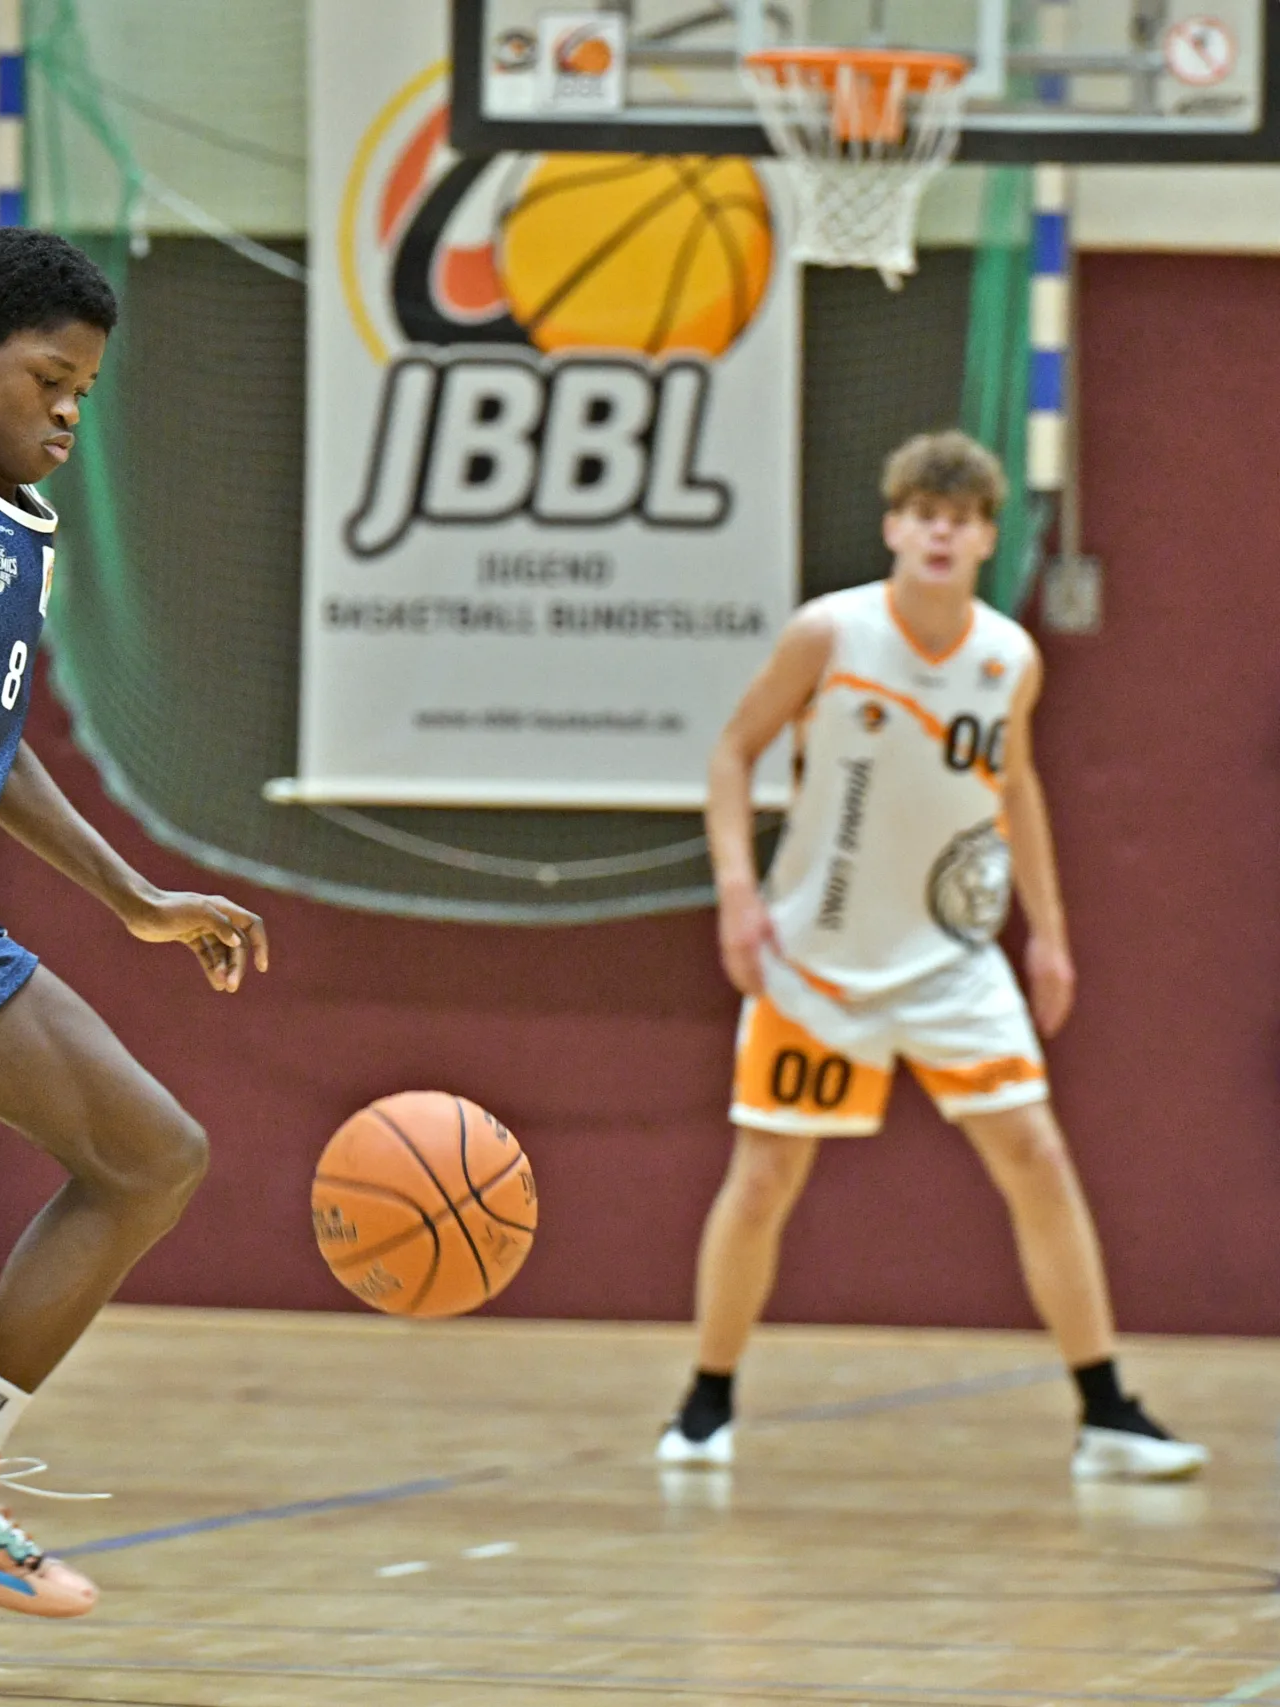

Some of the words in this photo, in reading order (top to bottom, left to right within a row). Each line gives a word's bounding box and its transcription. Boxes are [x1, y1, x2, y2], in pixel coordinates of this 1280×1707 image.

[344, 356, 733, 559] JBBL
[479, 550, 612, 586] JUGEND
[323, 598, 537, 634] BASKETBALL
[545, 599, 767, 638] BUNDESLIGA
[1, 640, 27, 711] 8
[771, 1049, 851, 1109] 00
